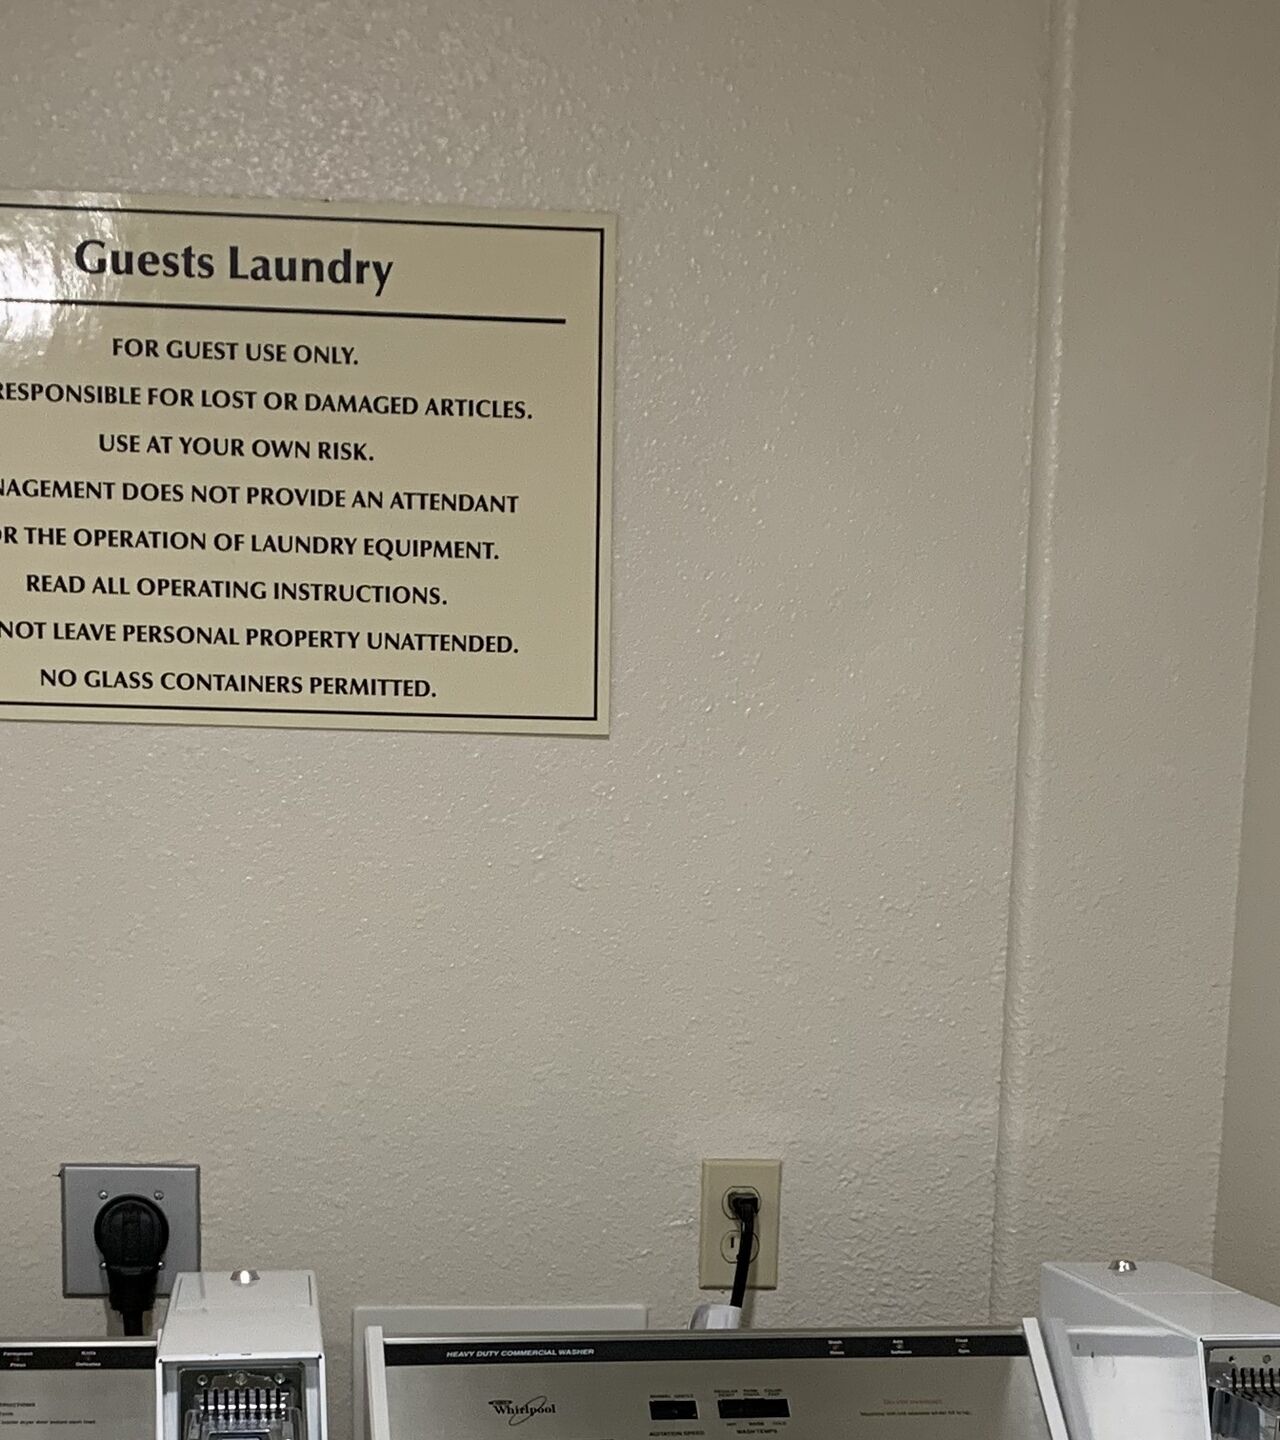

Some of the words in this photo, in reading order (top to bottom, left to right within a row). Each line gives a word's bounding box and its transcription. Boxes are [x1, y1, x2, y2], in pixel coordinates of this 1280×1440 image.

[74, 238, 215, 280] Guests
[228, 244, 395, 298] Laundry
[112, 337, 160, 358] FOR
[165, 339, 240, 361] GUEST
[245, 342, 287, 363] USE
[293, 344, 359, 366] ONLY.
[147, 387, 195, 408] FOR
[201, 389, 258, 410] LOST
[263, 391, 299, 412] OR
[304, 392, 419, 416] DAMAGED
[424, 397, 533, 420] ARTICLES.
[98, 433, 141, 454] USE
[146, 435, 174, 455] AT
[178, 436, 245, 457] YOUR
[251, 438, 311, 460] OWN
[317, 441, 374, 462] RISK.
[122, 482, 185, 503] DOES
[191, 484, 241, 505] NOT
[246, 486, 346, 508] PROVIDE
[351, 489, 384, 509] AN
[389, 491, 520, 514] ATTENDANT
[23, 526, 67, 547] THE
[73, 527, 207, 551] OPERATION
[213, 532, 245, 552] OF
[251, 534, 358, 556] LAUNDRY
[363, 537, 500, 562] EQUIPMENT.
[26, 574, 86, 594] READ
[91, 575, 131, 596] ALL
[136, 577, 267, 600] OPERATING
[273, 581, 448, 606] INSTRUCTIONS.
[53, 622, 117, 642] LEAVE
[122, 624, 241, 646] PERSONAL
[245, 627, 361, 649] PROPERTY
[366, 631, 519, 654] UNATTENDED.
[40, 668, 78, 688] NO
[83, 669, 154, 690] GLASS
[160, 671, 304, 695] CONTAINERS
[309, 676, 437, 698] PERMITTED.
[501, 1349, 557, 1357] COMMERCIAL
[558, 1348, 595, 1356] WASHER
